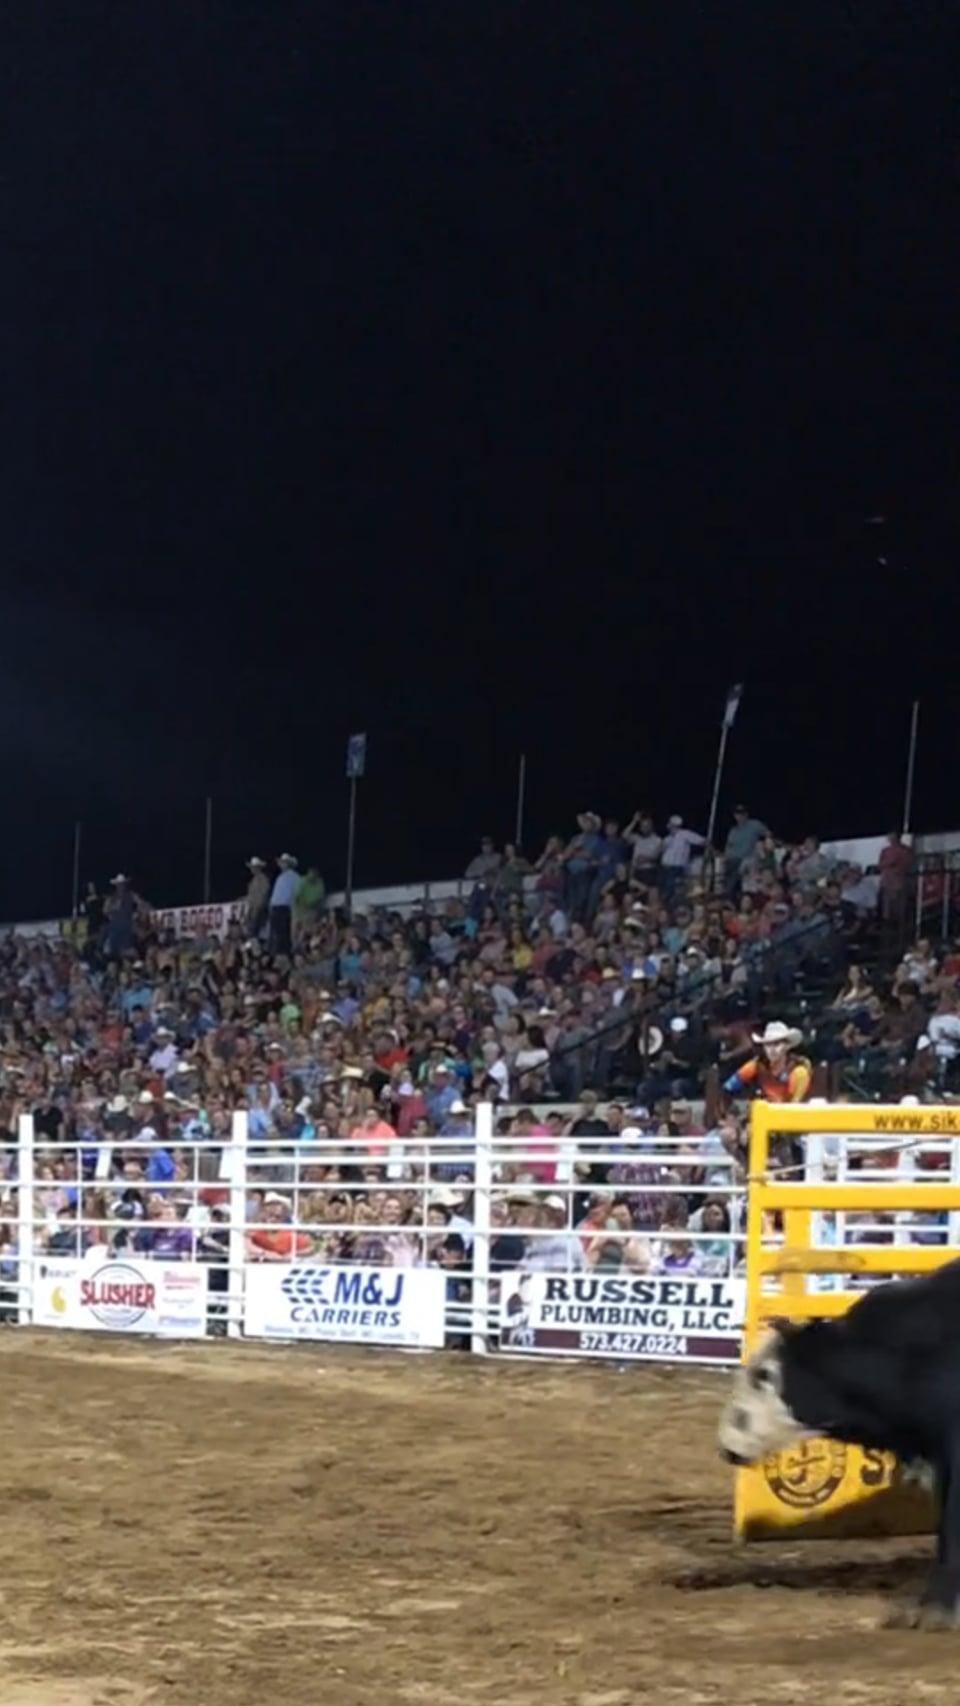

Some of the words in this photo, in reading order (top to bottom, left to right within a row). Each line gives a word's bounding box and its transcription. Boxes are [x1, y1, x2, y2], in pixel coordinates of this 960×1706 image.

[80, 1279, 156, 1311] SLUSHER
[333, 1271, 405, 1307] M&J
[544, 1277, 734, 1308] RUSSELL
[289, 1306, 402, 1328] CARRIERS
[540, 1304, 676, 1331] PLUMBING,
[579, 1331, 688, 1355] 573.427.0224
